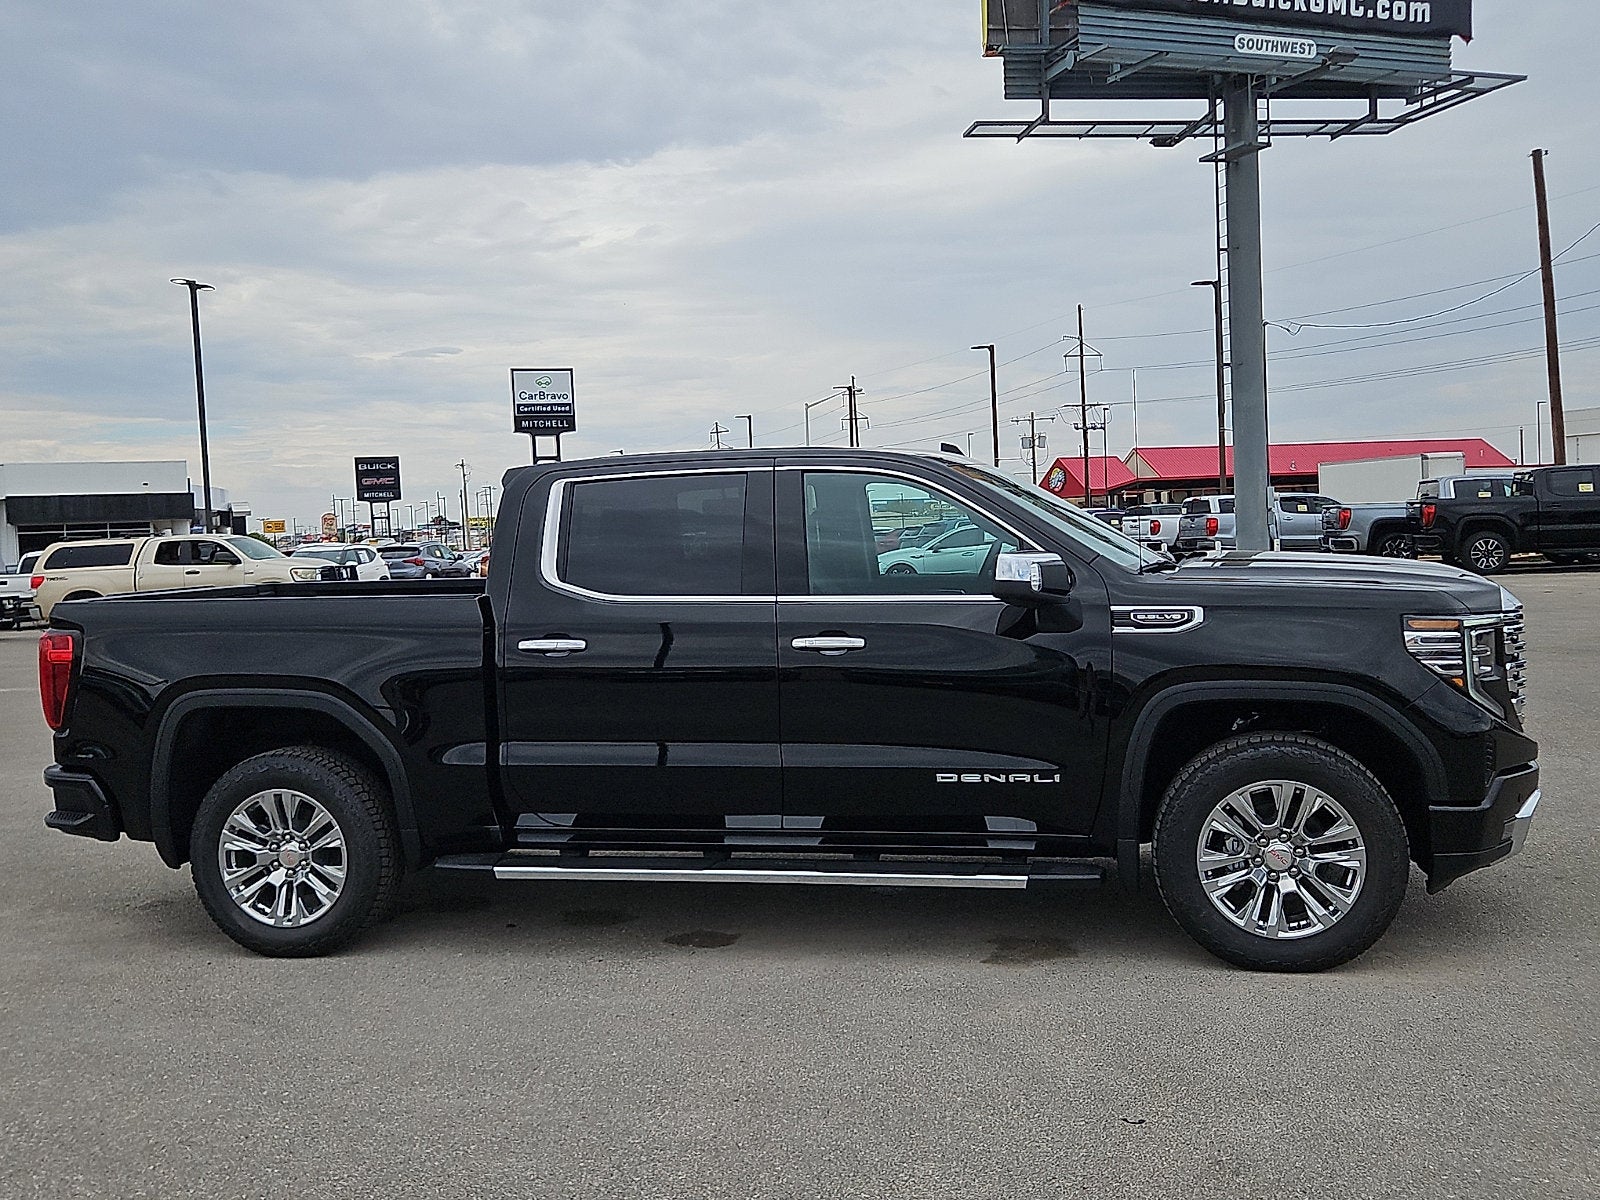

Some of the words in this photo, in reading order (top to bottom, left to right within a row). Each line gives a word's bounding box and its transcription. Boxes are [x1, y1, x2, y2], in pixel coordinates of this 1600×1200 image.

[1237, 37, 1315, 56] SOUTHWEST
[518, 390, 569, 401] CarBravo
[521, 420, 569, 428] MITCHELL
[361, 477, 395, 486] GMC
[935, 773, 1061, 783] DENALI
[1269, 849, 1288, 866] GMC
